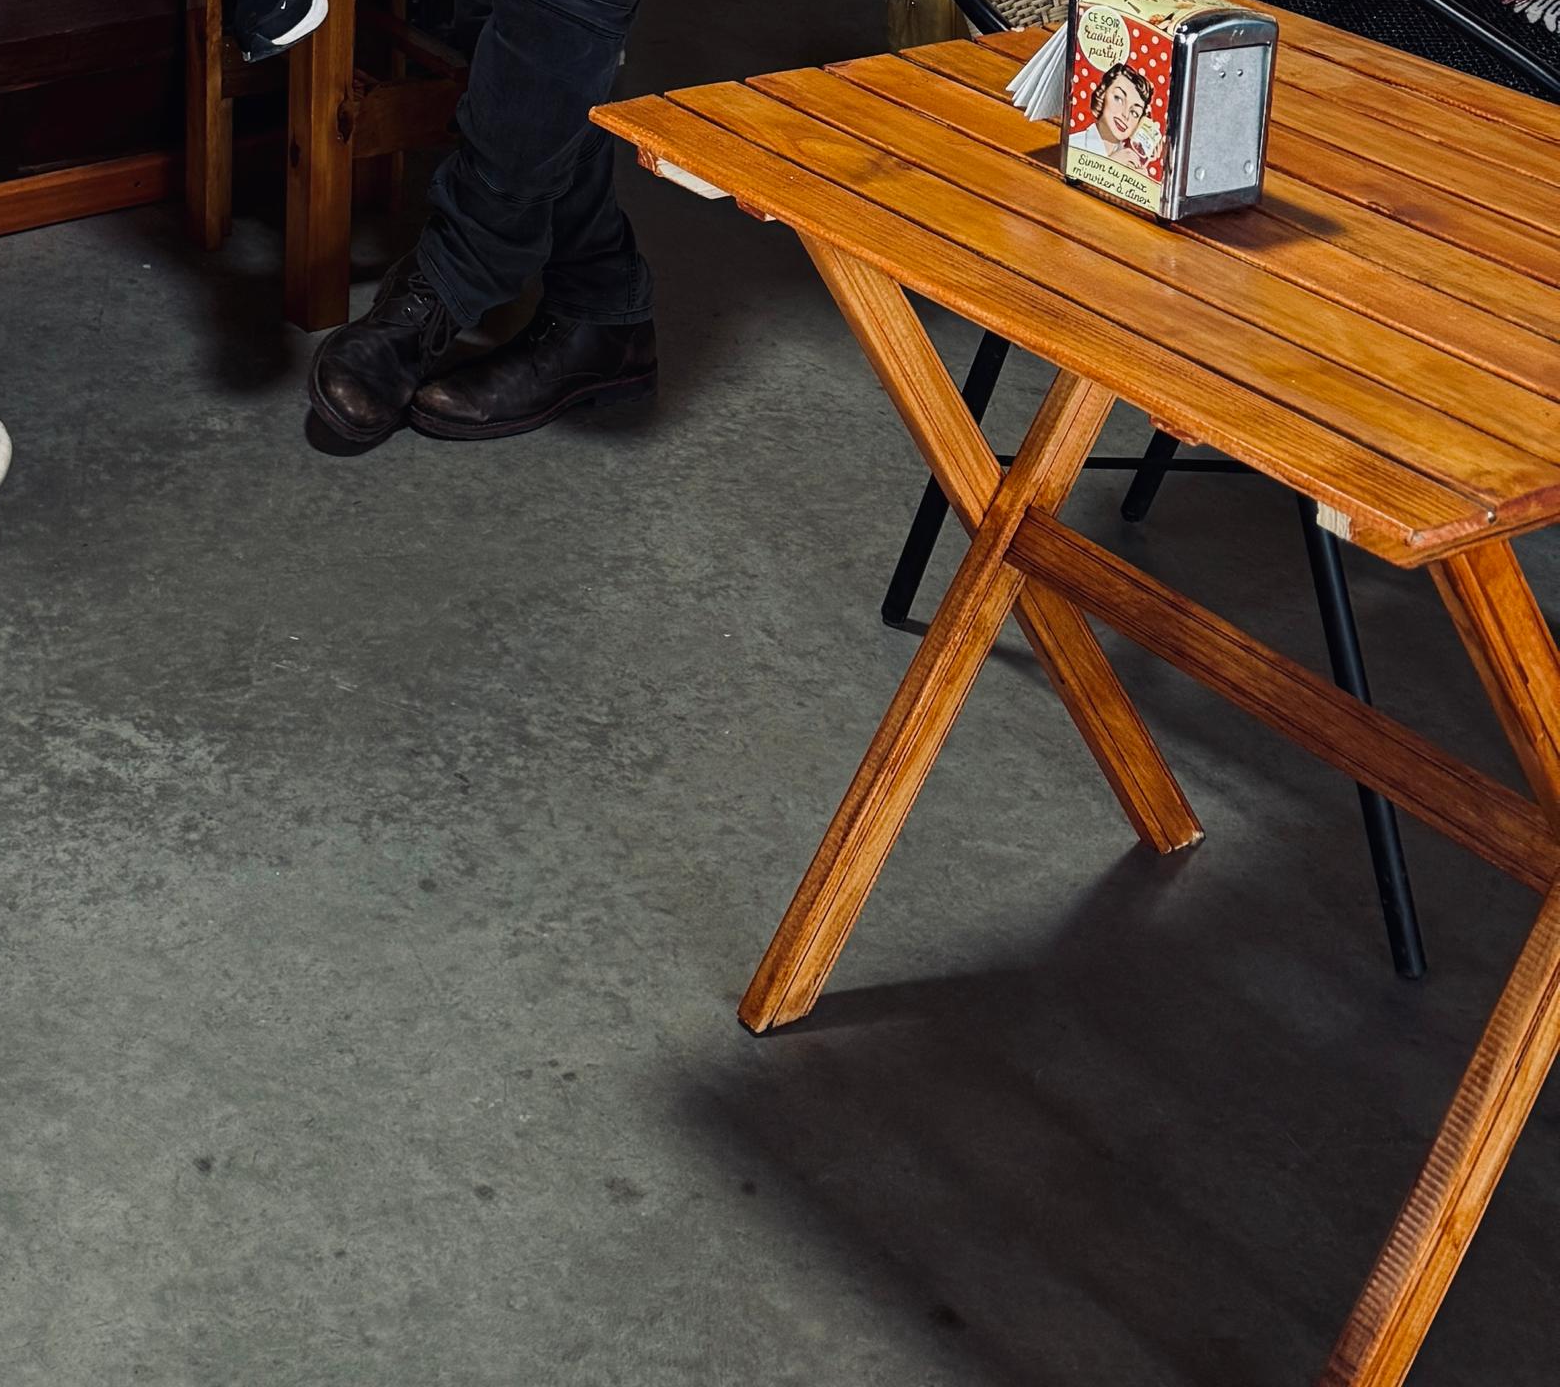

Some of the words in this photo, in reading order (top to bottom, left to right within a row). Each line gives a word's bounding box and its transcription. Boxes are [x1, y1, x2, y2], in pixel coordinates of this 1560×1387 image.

[1088, 12, 1098, 23] CE
[1101, 15, 1121, 28] SOIR
[1078, 153, 1106, 173] Sinon
[1108, 166, 1120, 179] tu
[1120, 173, 1148, 193] peux
